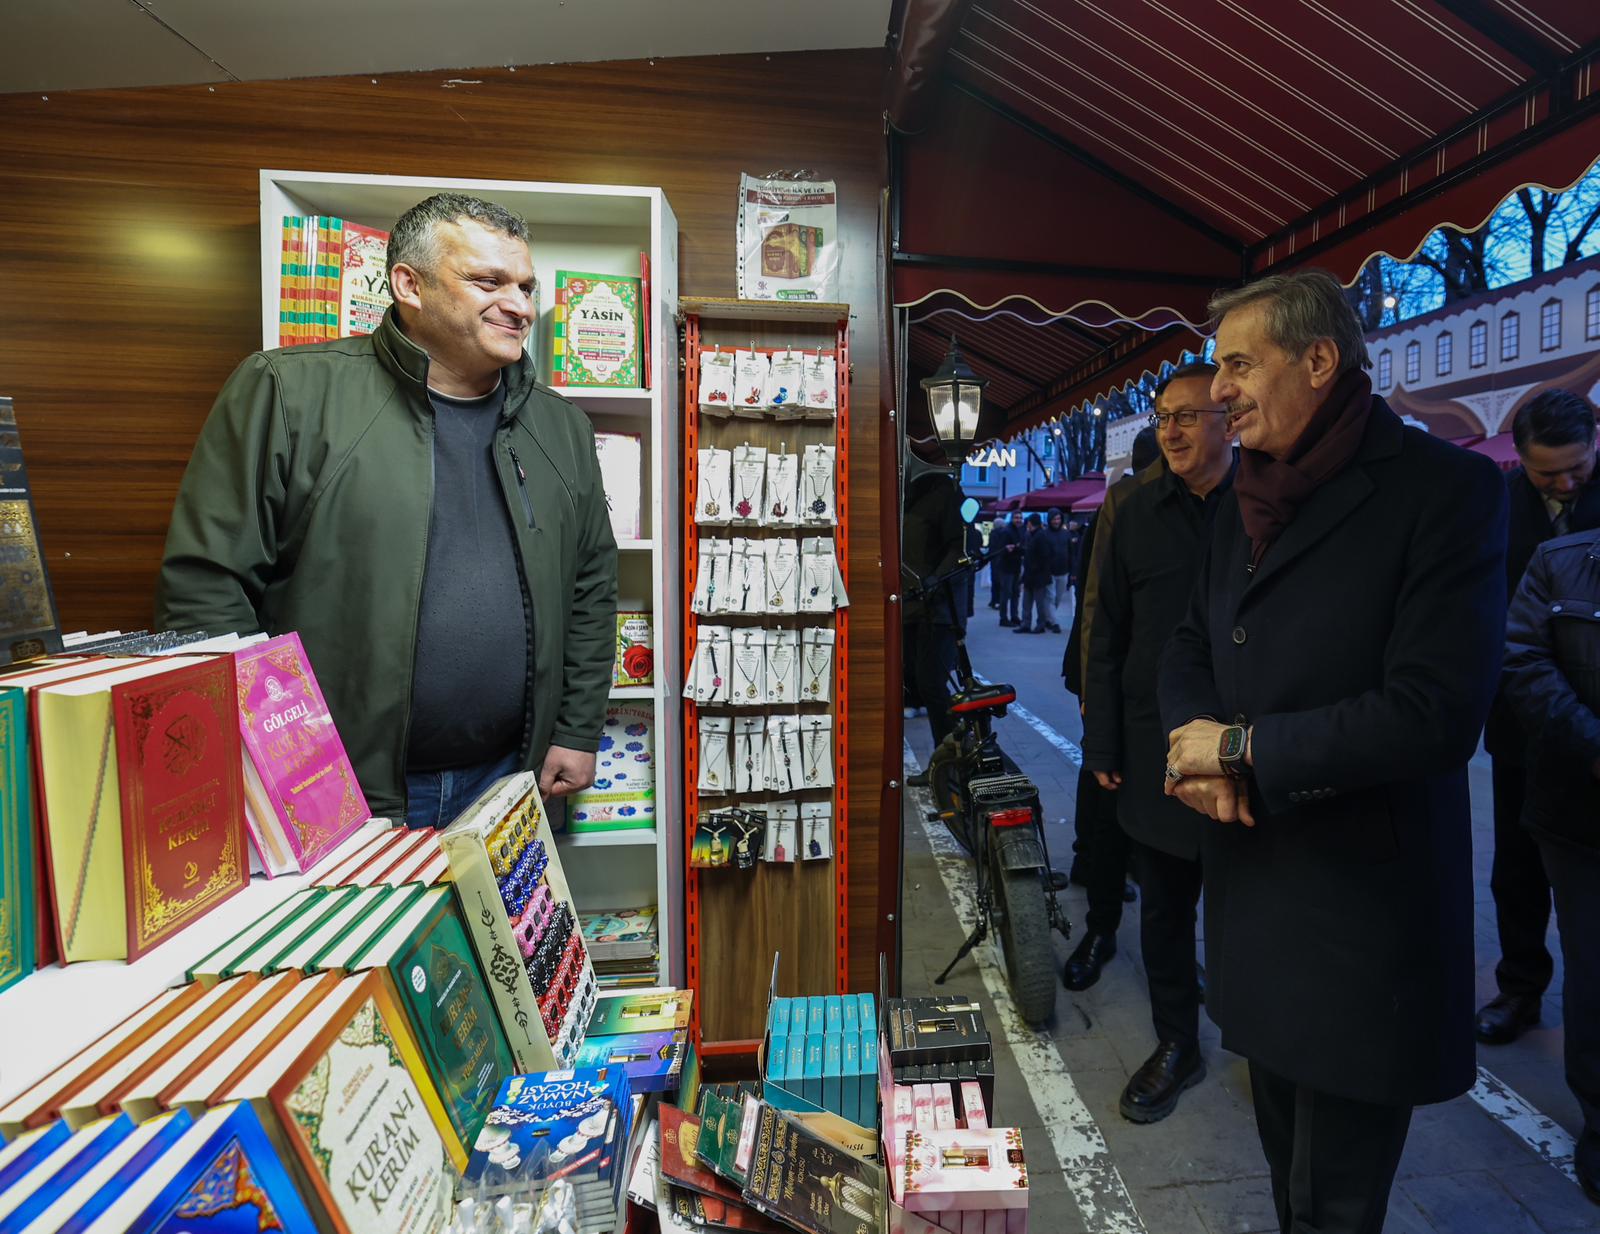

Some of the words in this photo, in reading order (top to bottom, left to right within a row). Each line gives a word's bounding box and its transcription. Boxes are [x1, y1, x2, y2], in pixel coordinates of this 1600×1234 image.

[580, 307, 624, 321] YÂSİN
[263, 699, 309, 733] GÖLGELİ
[523, 1080, 590, 1095] HOCASI
[518, 1089, 588, 1105] NAMAZ
[345, 1088, 415, 1202] KUR'AN-I
